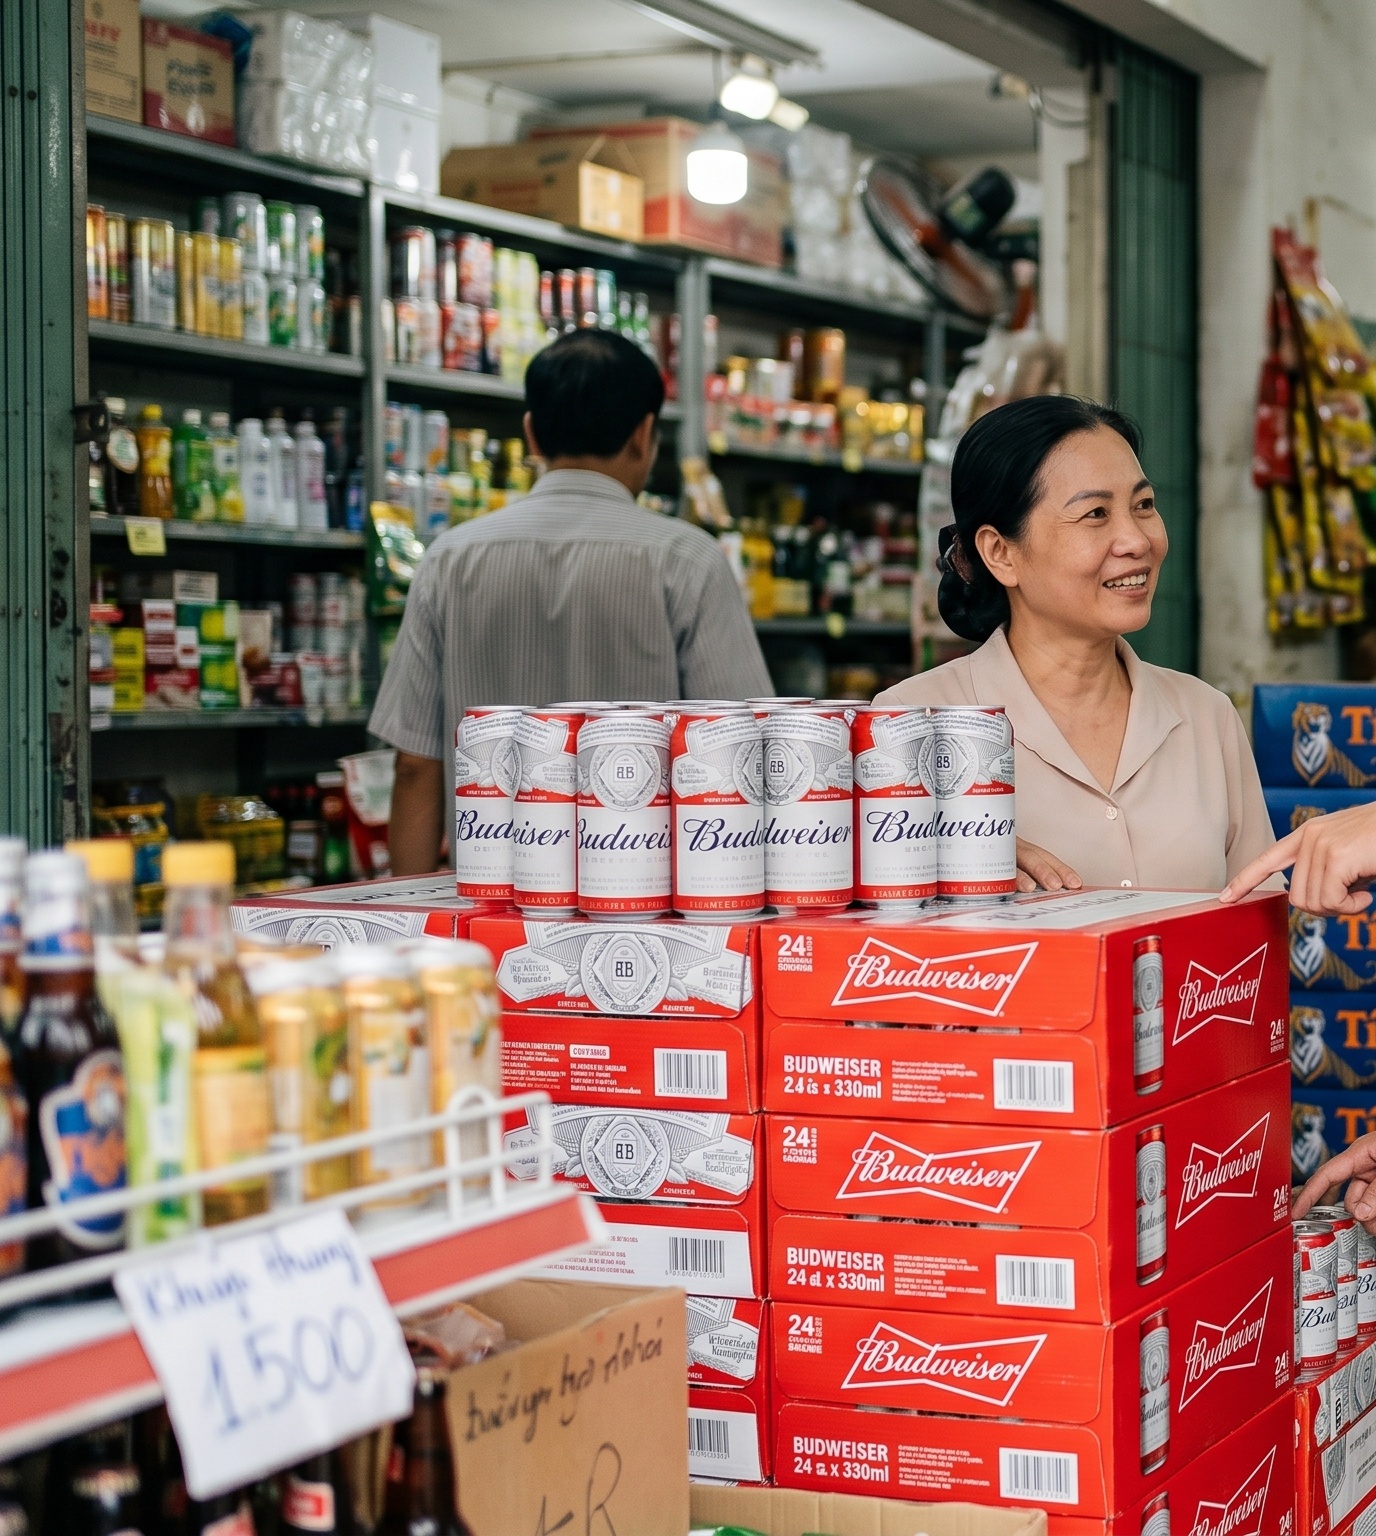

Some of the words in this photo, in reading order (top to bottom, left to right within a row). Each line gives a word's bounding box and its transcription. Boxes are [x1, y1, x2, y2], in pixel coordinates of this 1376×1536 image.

[778, 934, 807, 957] 24
[847, 955, 1013, 991] Budweiser
[1178, 975, 1259, 1021] Budweiser
[783, 1055, 882, 1077] BUDWEISER
[784, 1077, 804, 1094] 24
[834, 1079, 882, 1099] 330ml
[782, 1126, 811, 1148] 24
[852, 1150, 1017, 1188] Budweiser
[1182, 1148, 1260, 1203] Budweiser
[787, 1247, 885, 1271] BUDWEISER
[787, 1268, 807, 1286] 24
[837, 1273, 885, 1292] 330ml
[787, 1314, 816, 1337] 24
[856, 1340, 1022, 1381] Budweiser
[1185, 1317, 1264, 1383] Budweiser
[793, 1436, 889, 1462] BUDWEISER
[793, 1457, 812, 1474] 24
[842, 1463, 889, 1482] 330ml
